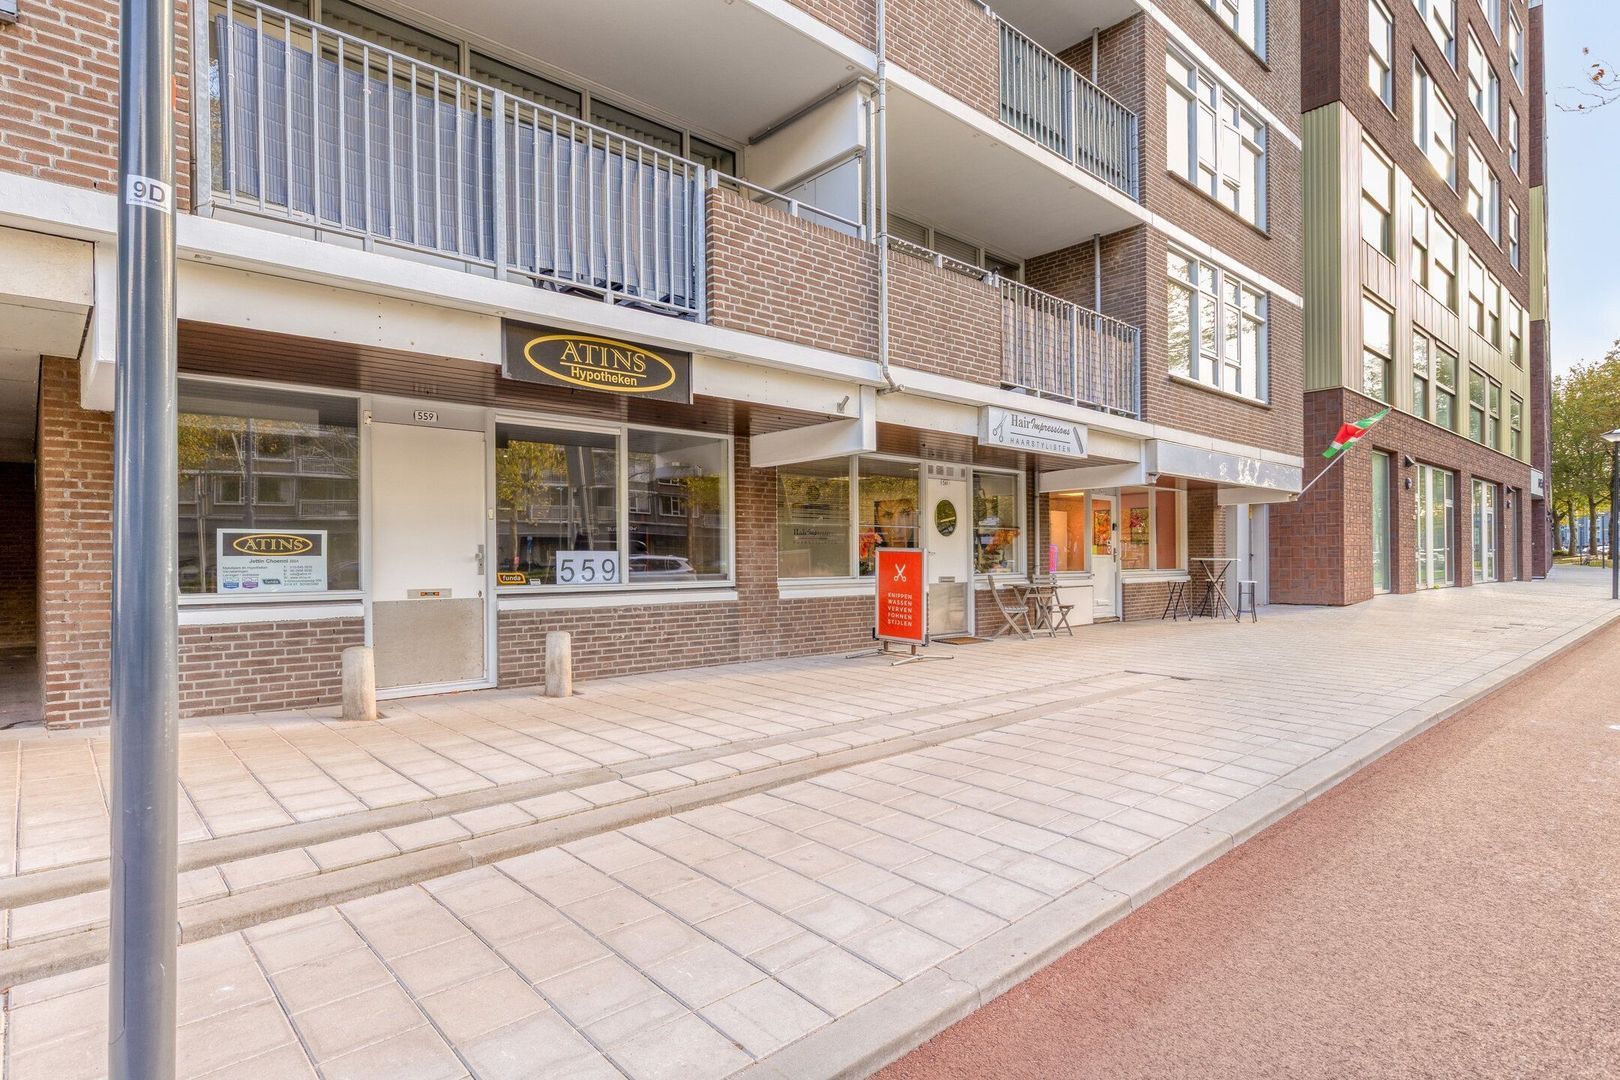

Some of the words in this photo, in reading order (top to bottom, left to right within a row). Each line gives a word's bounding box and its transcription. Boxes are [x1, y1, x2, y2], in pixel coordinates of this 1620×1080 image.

[133, 181, 166, 203] 9D
[560, 341, 647, 373] ATINS
[571, 367, 637, 386] Hypotheken
[417, 411, 434, 421] 559
[1009, 438, 1071, 452] HAARSTYLISTEN
[244, 539, 303, 550] ATINS
[560, 558, 616, 583] 559
[888, 592, 912, 600] KNIPPEN
